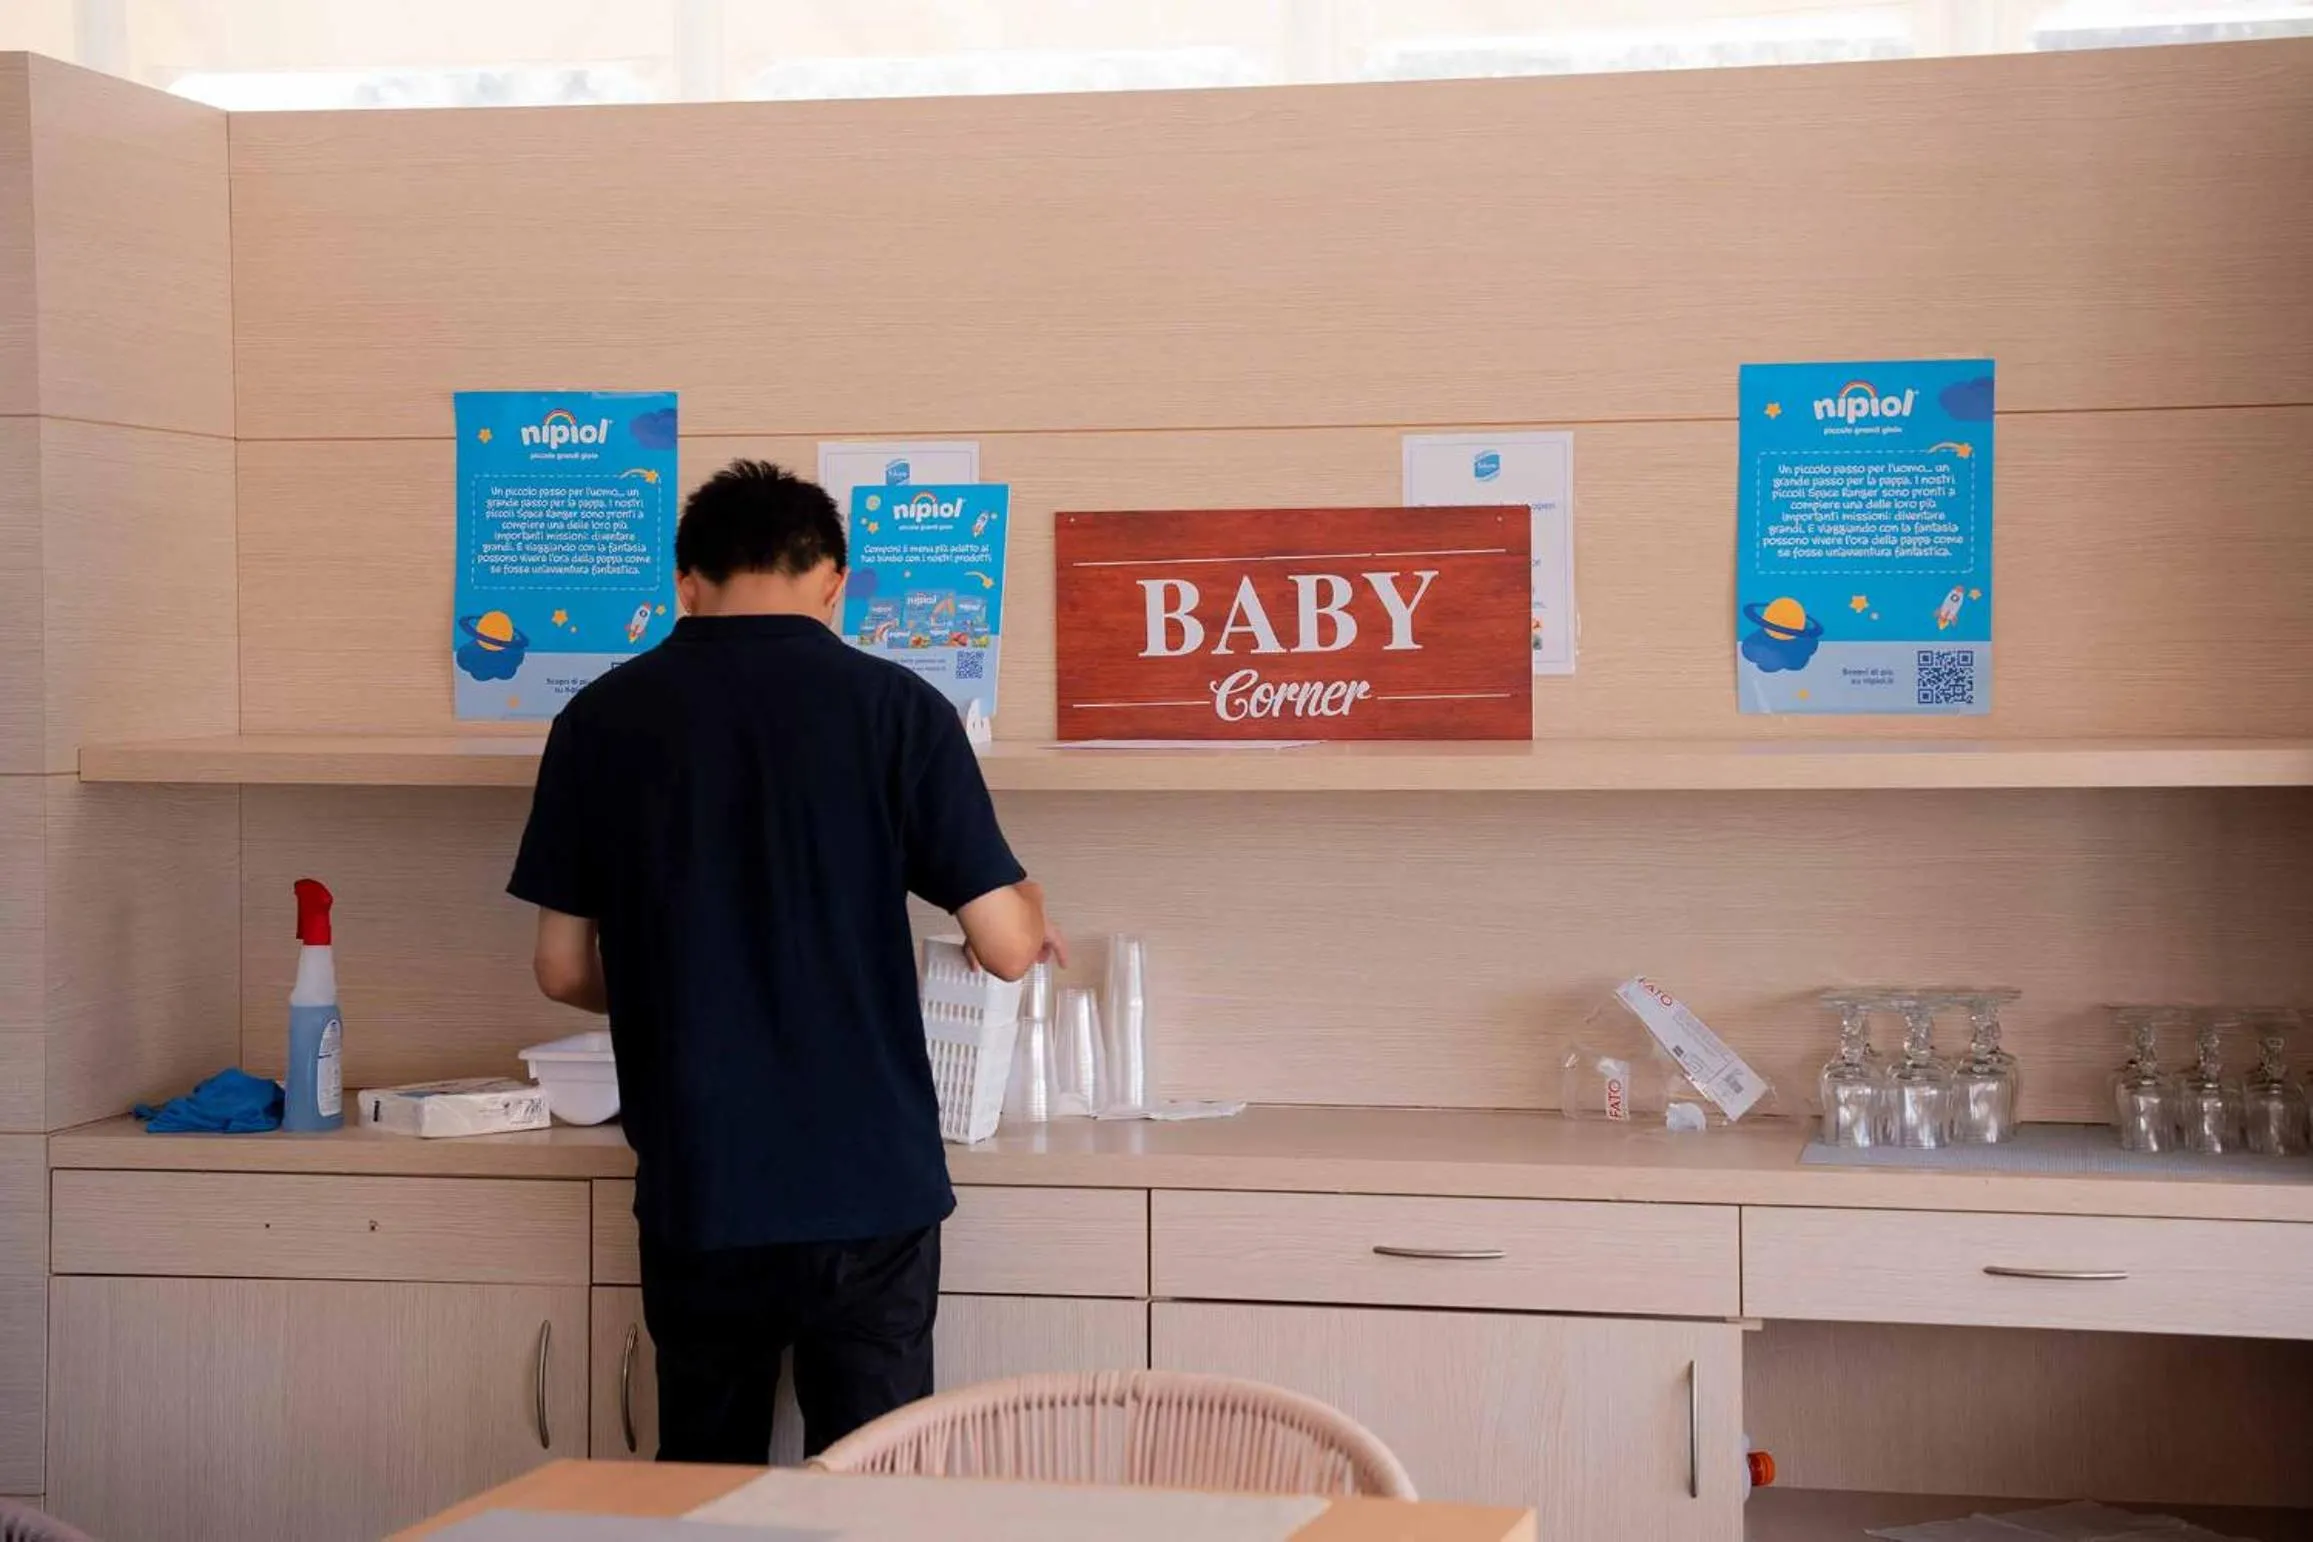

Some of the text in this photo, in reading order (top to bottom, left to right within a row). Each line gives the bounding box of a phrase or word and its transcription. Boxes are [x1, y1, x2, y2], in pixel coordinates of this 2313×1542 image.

[1813, 388, 1913, 423] nipiol
[521, 418, 610, 449] nipiol
[1778, 465, 1793, 474] Un
[1794, 463, 1832, 477] piccolo
[1833, 465, 1865, 476] passo
[1867, 465, 1885, 477] per
[1934, 465, 1950, 473] un
[1773, 475, 1956, 489] grande passo per la pappa. I nostri
[491, 486, 504, 496] Un
[505, 486, 538, 498] piccolo
[539, 487, 567, 499] passo
[568, 488, 583, 499] per
[627, 488, 640, 497] un
[1772, 487, 1956, 501] piccoli Space Ranger sono pronti a
[892, 497, 963, 523] nipiol
[1790, 500, 1937, 512] compiere una delle loro più
[1763, 535, 1964, 548] possono vivere l'ora della pappa come
[1777, 547, 1953, 559] se fosse un'avventura fantastica.
[1136, 571, 1439, 658] BABY
[1209, 669, 1372, 723] Corner
[1607, 1078, 1622, 1120] FATO
